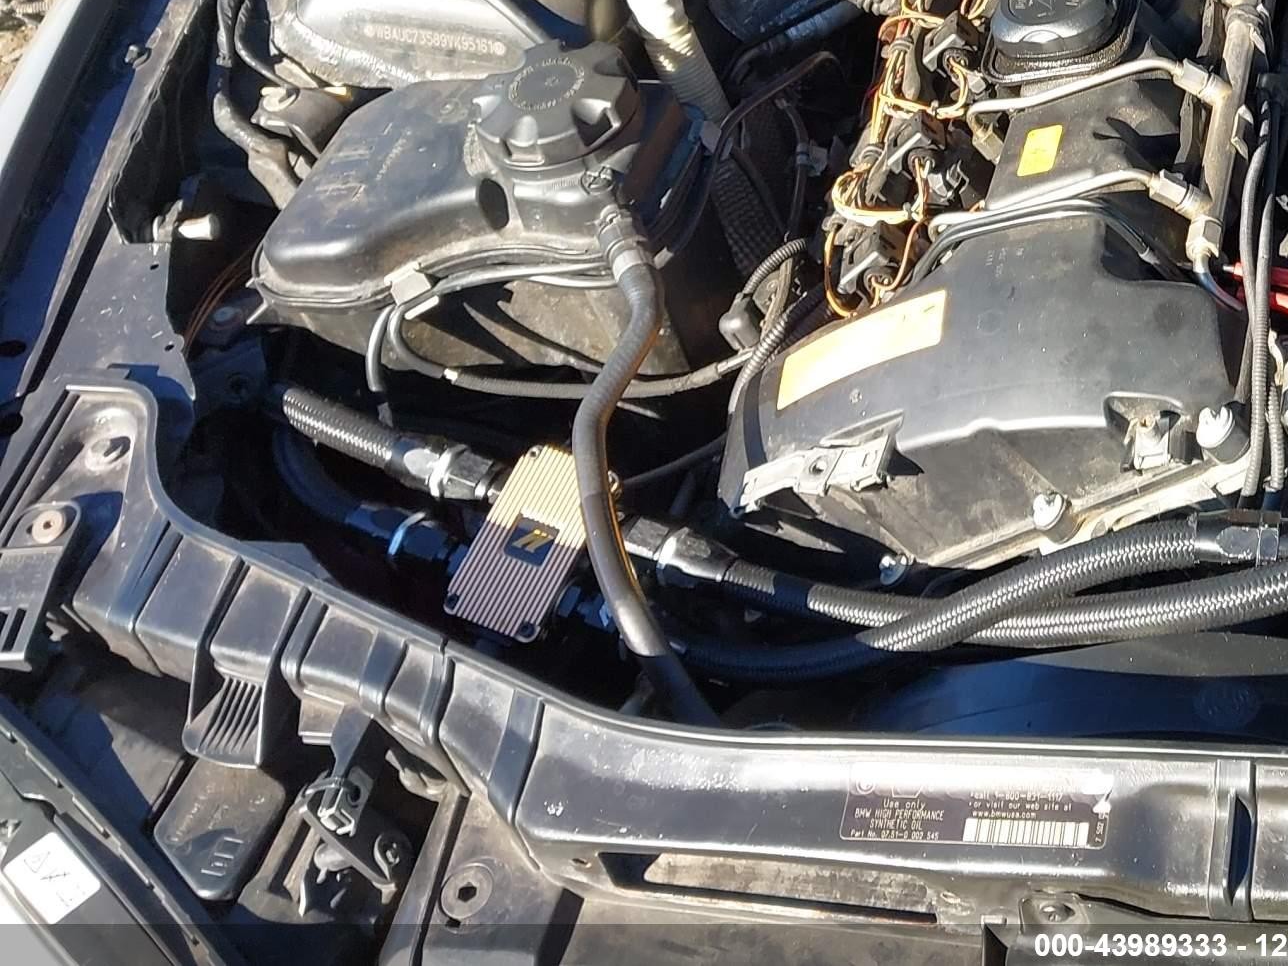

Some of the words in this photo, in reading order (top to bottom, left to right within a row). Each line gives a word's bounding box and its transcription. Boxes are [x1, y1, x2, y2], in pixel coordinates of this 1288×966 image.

[883, 798, 899, 808] Use
[905, 799, 926, 810] only
[986, 801, 1004, 809] visit
[1008, 802, 1020, 810] our
[1025, 802, 1040, 810] web
[1043, 803, 1059, 811] site
[1063, 803, 1072, 812] at
[854, 808, 871, 818] BMW
[874, 809, 892, 819] HIGH
[894, 809, 945, 821] PERFORMANCE
[972, 809, 1037, 819] www.bmwusa.com
[870, 818, 908, 830] SYNTHETIC
[911, 820, 922, 830] OIL
[850, 829, 864, 837] Part
